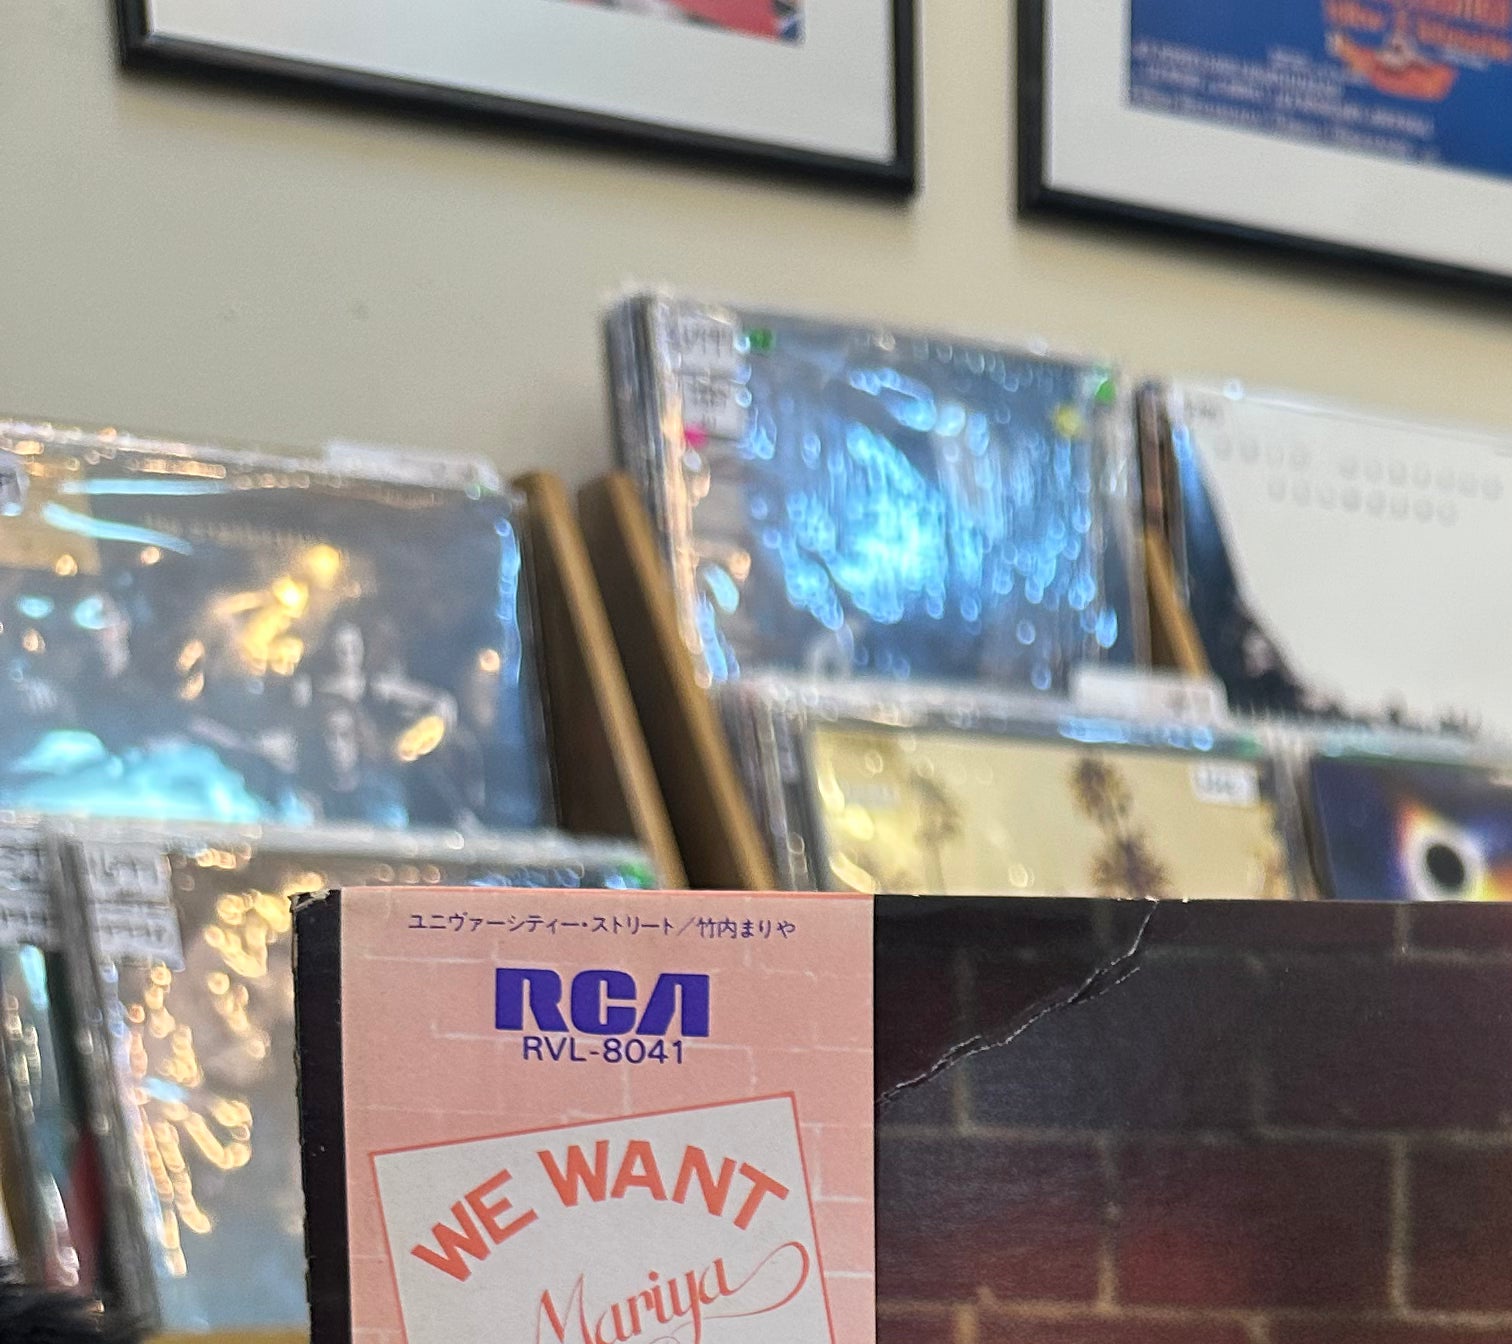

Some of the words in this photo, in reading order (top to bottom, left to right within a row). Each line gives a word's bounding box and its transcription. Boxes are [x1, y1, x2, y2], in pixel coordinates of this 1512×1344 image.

[494, 967, 710, 1037] RCA
[522, 1035, 686, 1065] RVL-8041
[410, 1168, 540, 1283] WE
[535, 1138, 791, 1232] WANT
